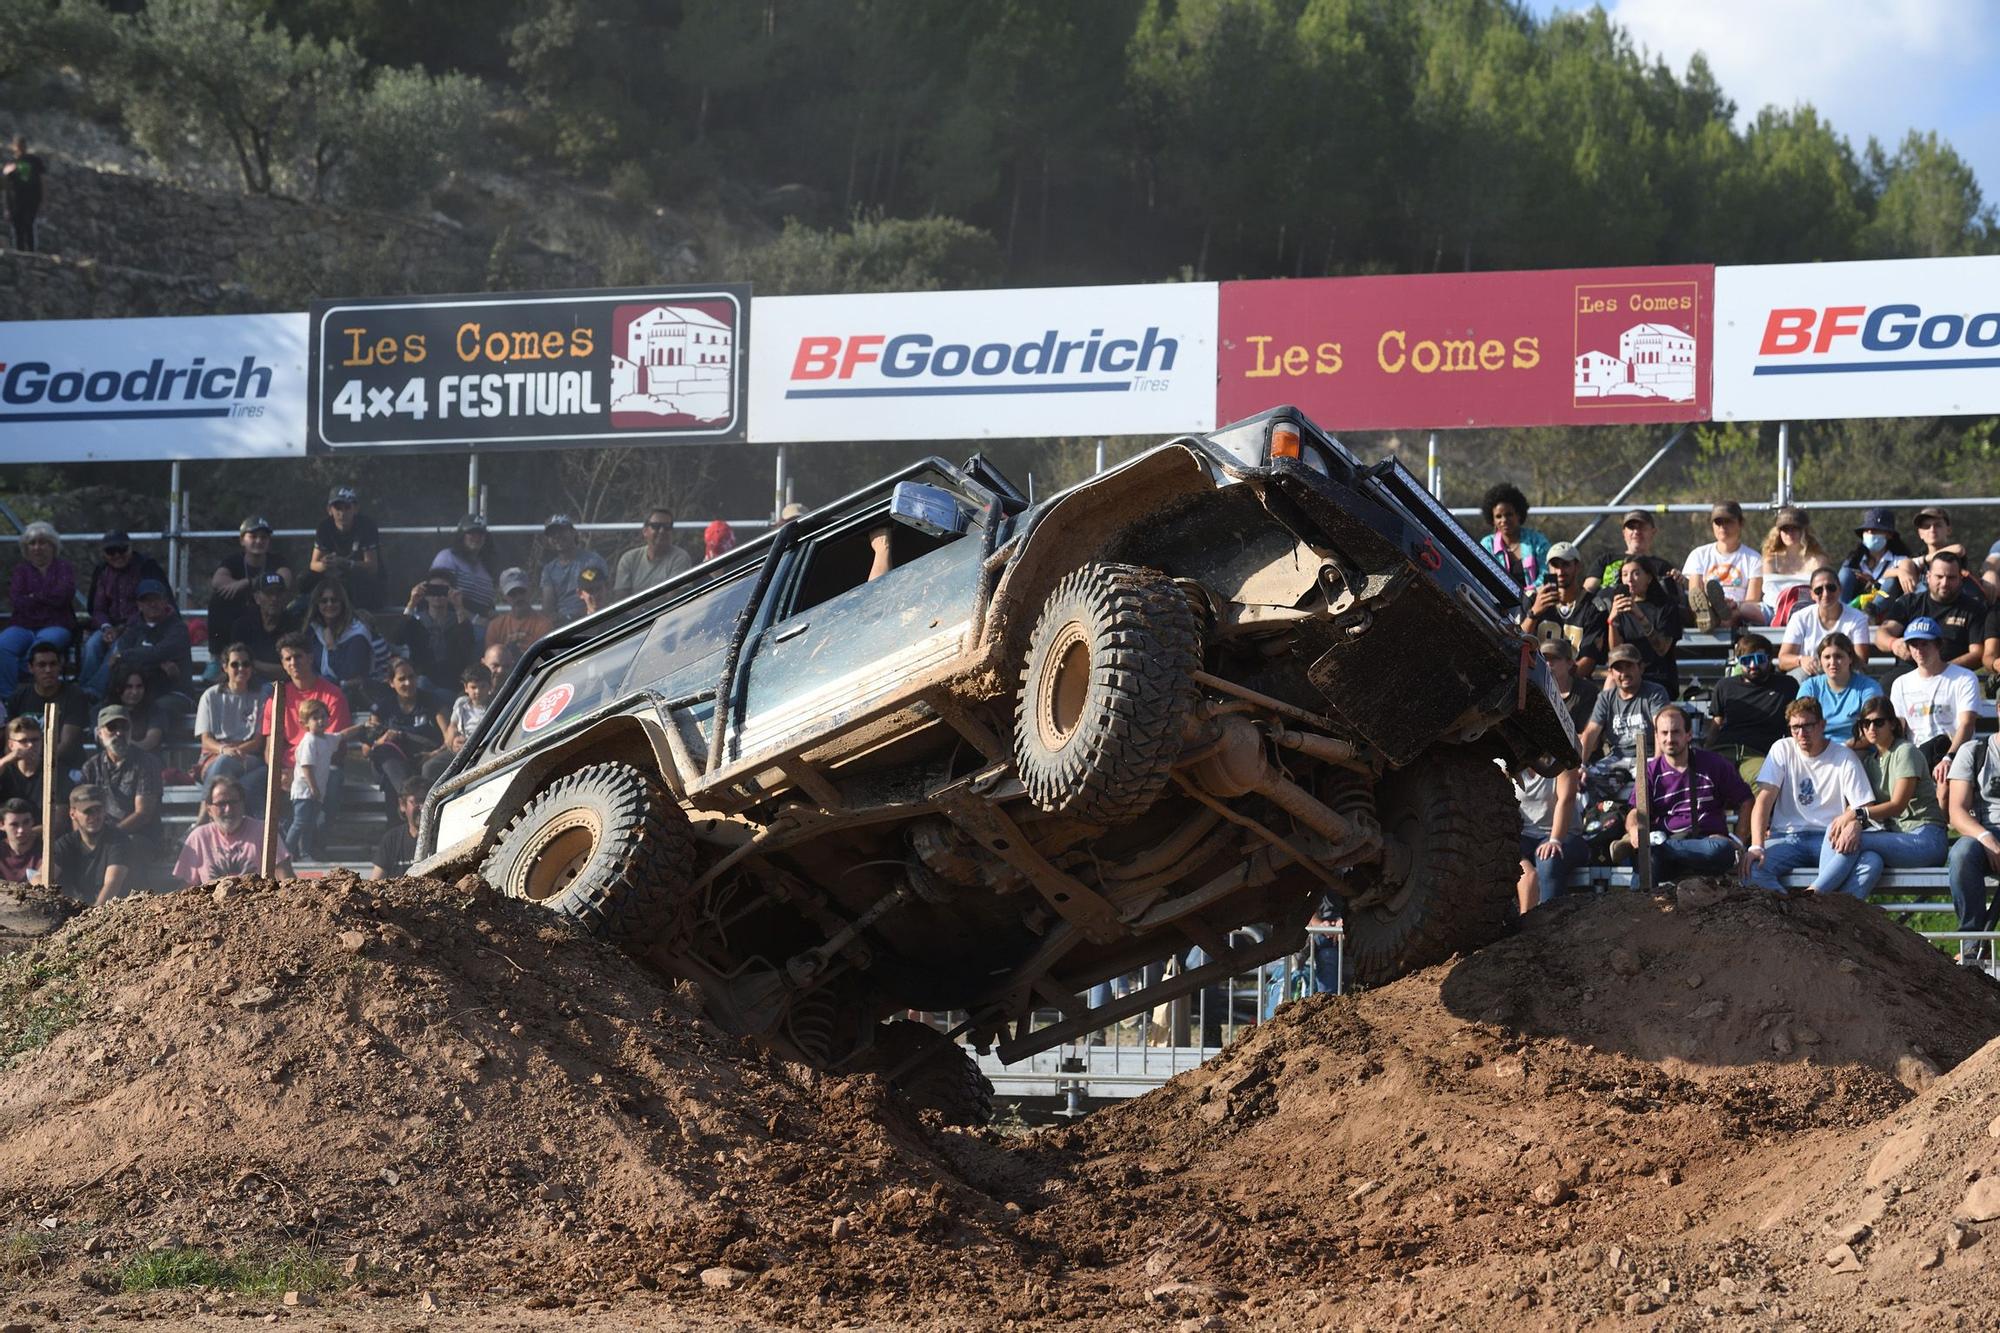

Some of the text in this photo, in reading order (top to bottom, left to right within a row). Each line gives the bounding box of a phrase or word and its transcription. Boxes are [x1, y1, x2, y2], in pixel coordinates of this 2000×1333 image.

[1579, 294, 1692, 314] Les Comes
[343, 322, 594, 367] Les Comes
[790, 327, 1179, 381] BFGoodrich
[1245, 329, 1541, 378] Les Comes
[0, 356, 272, 405] Goodrich
[332, 378, 429, 422] 4x4
[1134, 376, 1169, 392] Tires
[231, 403, 265, 418] Tires
